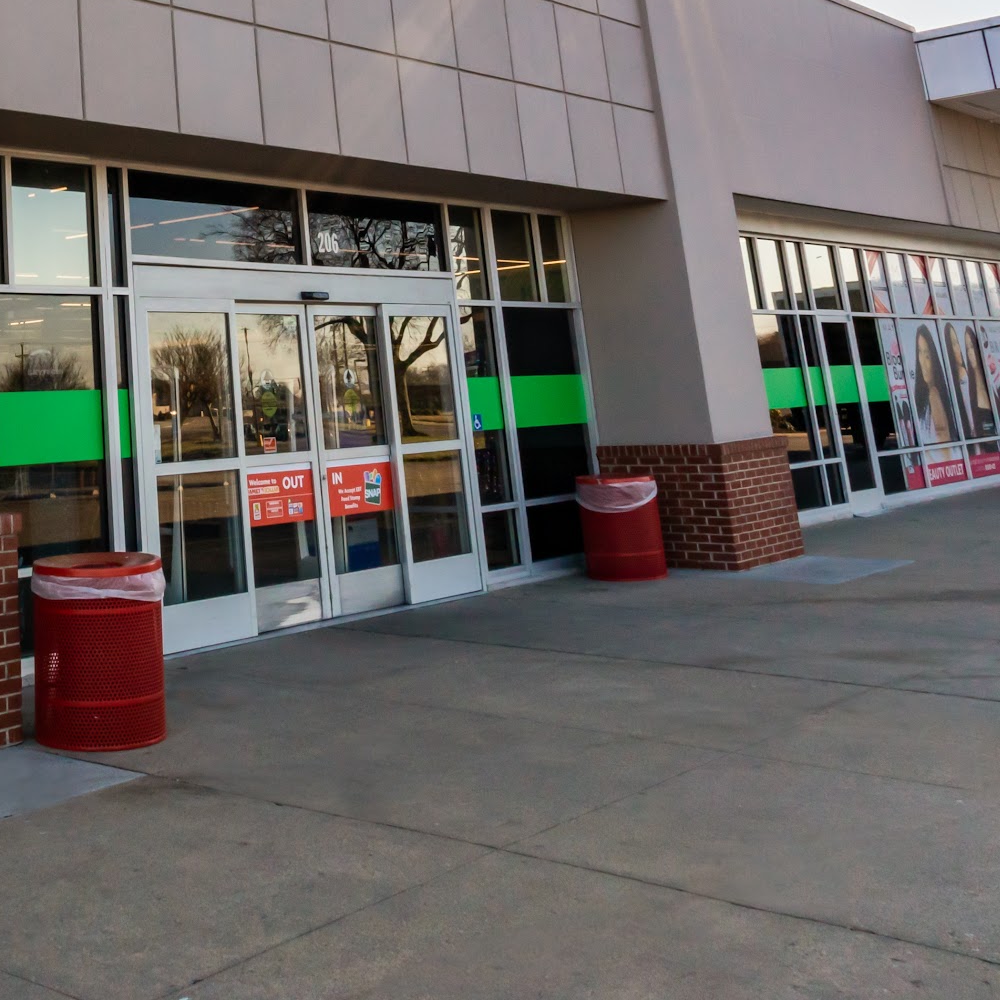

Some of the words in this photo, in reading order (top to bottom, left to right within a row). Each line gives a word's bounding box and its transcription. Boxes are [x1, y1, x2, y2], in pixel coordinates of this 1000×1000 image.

[318, 231, 339, 253] 206
[282, 475, 305, 490] OUT
[331, 471, 343, 485] IN
[365, 488, 381, 499] SNAP
